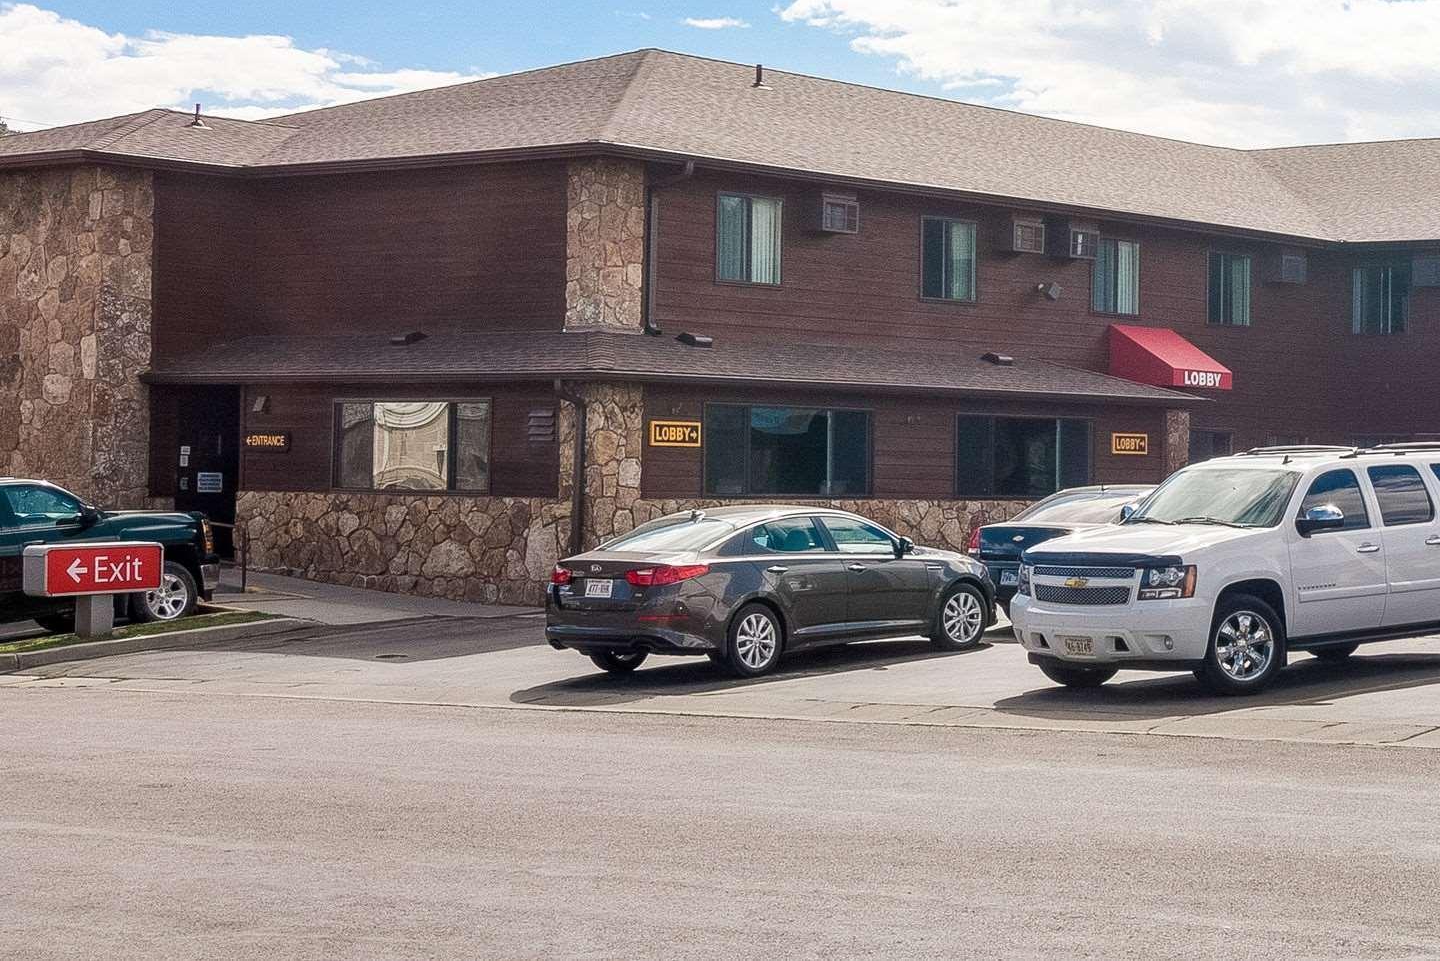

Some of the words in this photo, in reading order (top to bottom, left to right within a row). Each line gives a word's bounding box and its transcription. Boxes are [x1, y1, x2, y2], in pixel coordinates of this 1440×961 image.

[1184, 370, 1222, 387] LOBBY
[252, 435, 285, 446] ENTRANCE
[656, 426, 690, 441] LOBBY
[1116, 438, 1140, 450] LOBBY
[94, 555, 143, 583] Exit
